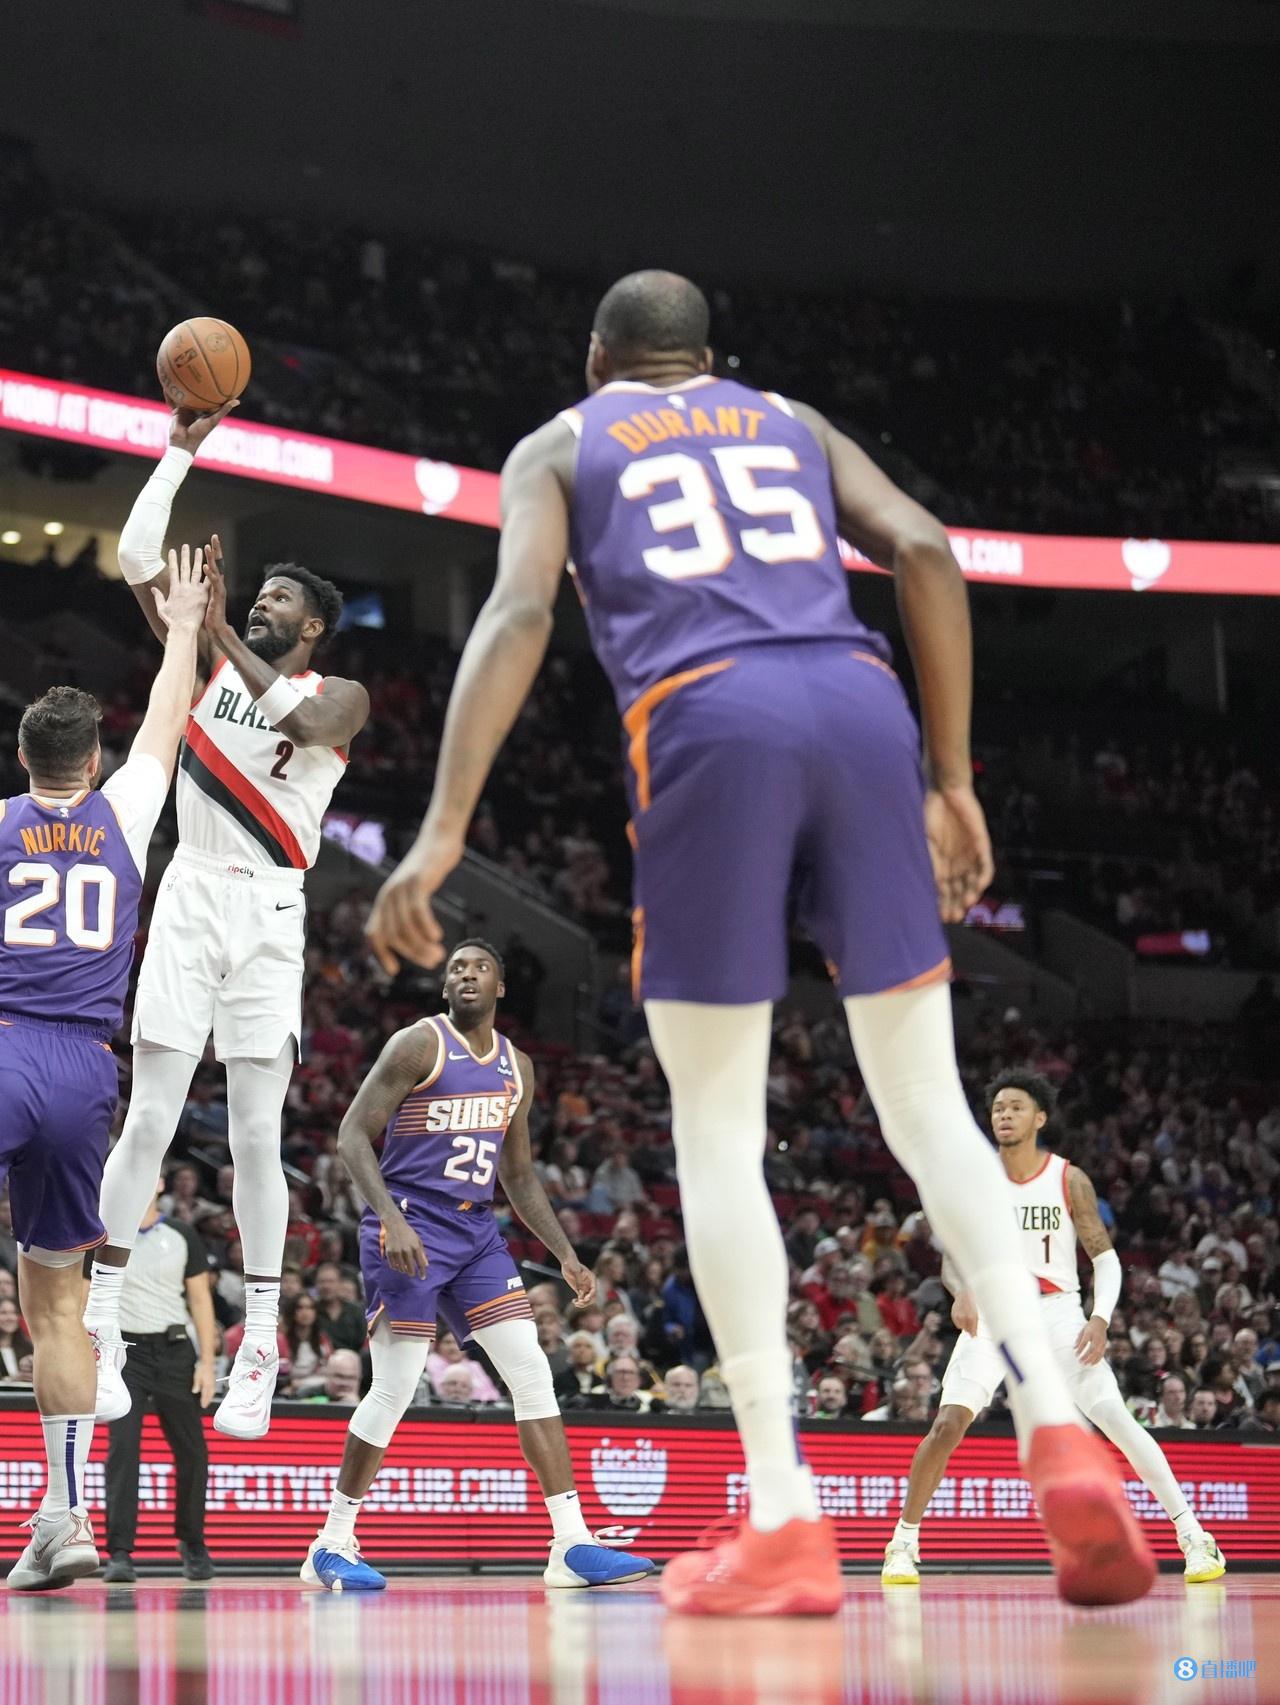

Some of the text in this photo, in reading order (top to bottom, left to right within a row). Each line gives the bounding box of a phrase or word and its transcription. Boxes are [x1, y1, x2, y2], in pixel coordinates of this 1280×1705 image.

[607, 406, 766, 455] DURANT
[618, 445, 826, 580] 35
[270, 740, 294, 781] 2
[20, 823, 106, 857] NURKIĆ
[3, 862, 117, 951] 20
[426, 1096, 507, 1132] SUNS
[443, 1135, 497, 1186] 25
[1041, 1234, 1050, 1264] 1
[861, 1475, 896, 1517] UP
